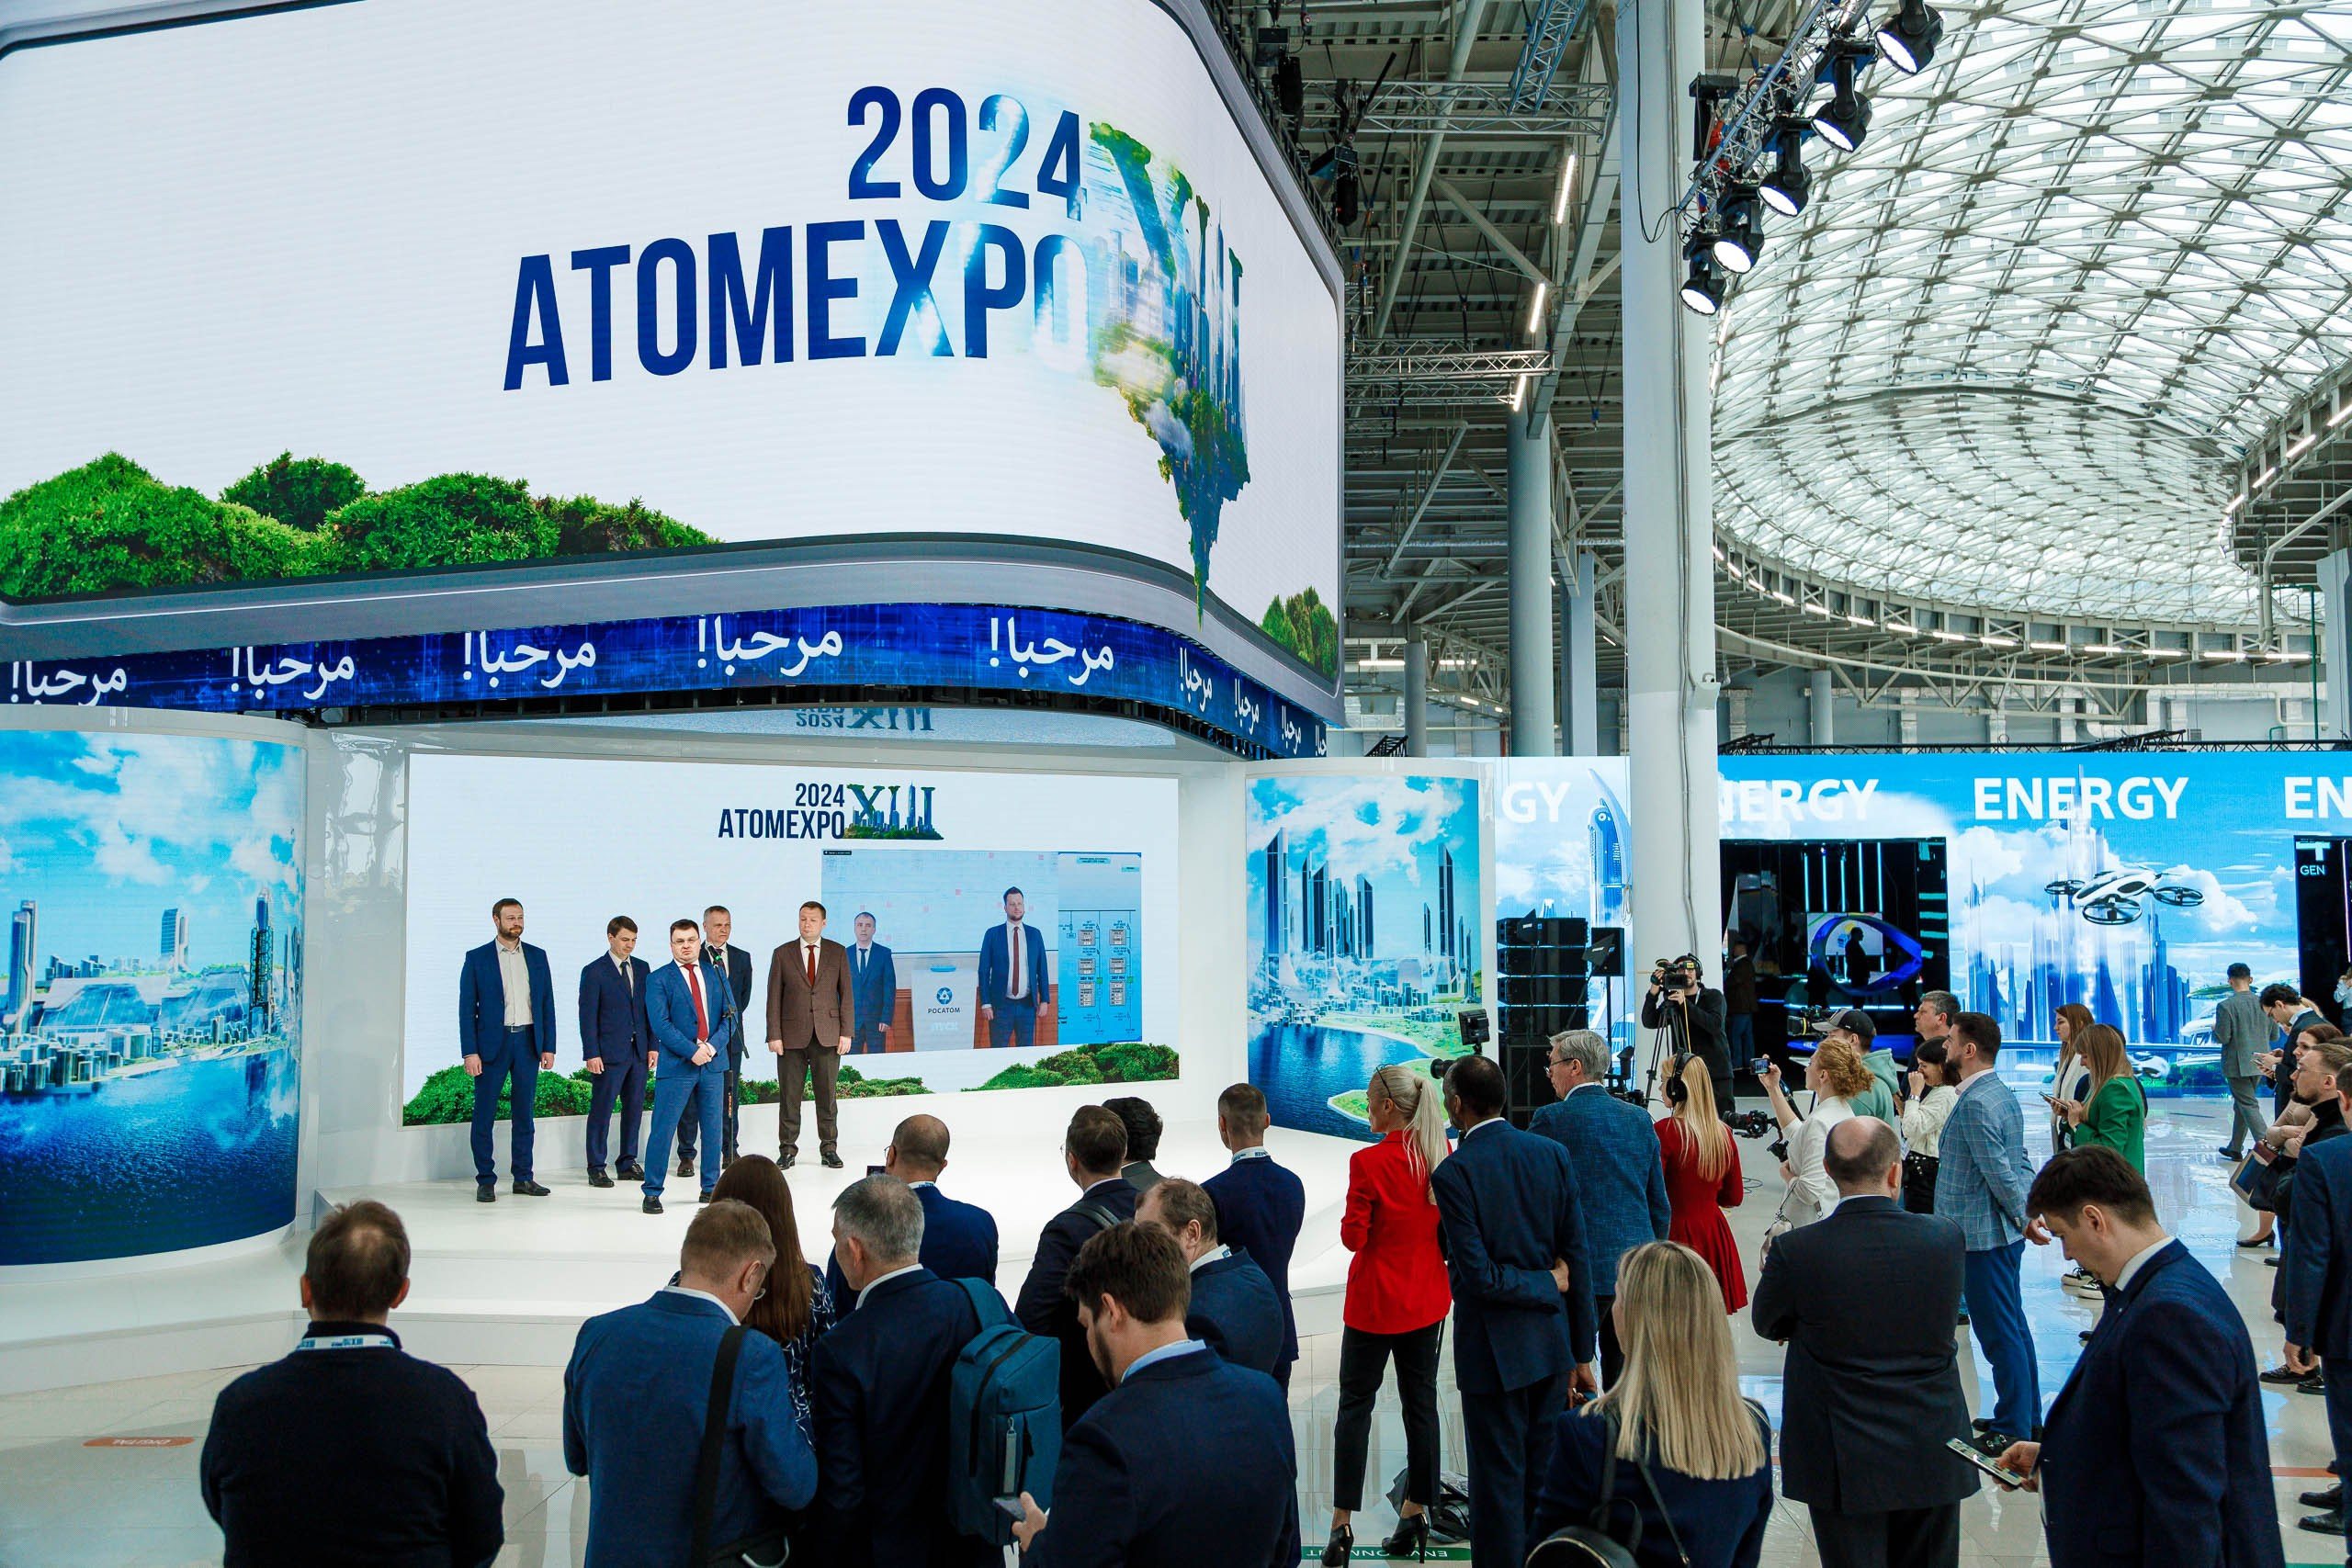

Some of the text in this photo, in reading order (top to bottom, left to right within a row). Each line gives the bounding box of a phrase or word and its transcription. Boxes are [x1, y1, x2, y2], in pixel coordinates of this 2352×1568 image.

[847, 85, 1087, 221] 2024
[503, 219, 1090, 391] ATOMEXPO
[231, 647, 356, 700] مرحبا!
[463, 630, 597, 688] مرحبا!
[697, 617, 843, 677] مرحبا!
[989, 616, 1114, 686] مرحبا!
[1180, 647, 1213, 712] مرحبا!
[795, 783, 845, 807] 2024
[1974, 776, 2189, 820] ENERGY
[718, 808, 845, 840] ATOMEXPO
[2300, 864, 2326, 876] GEN
